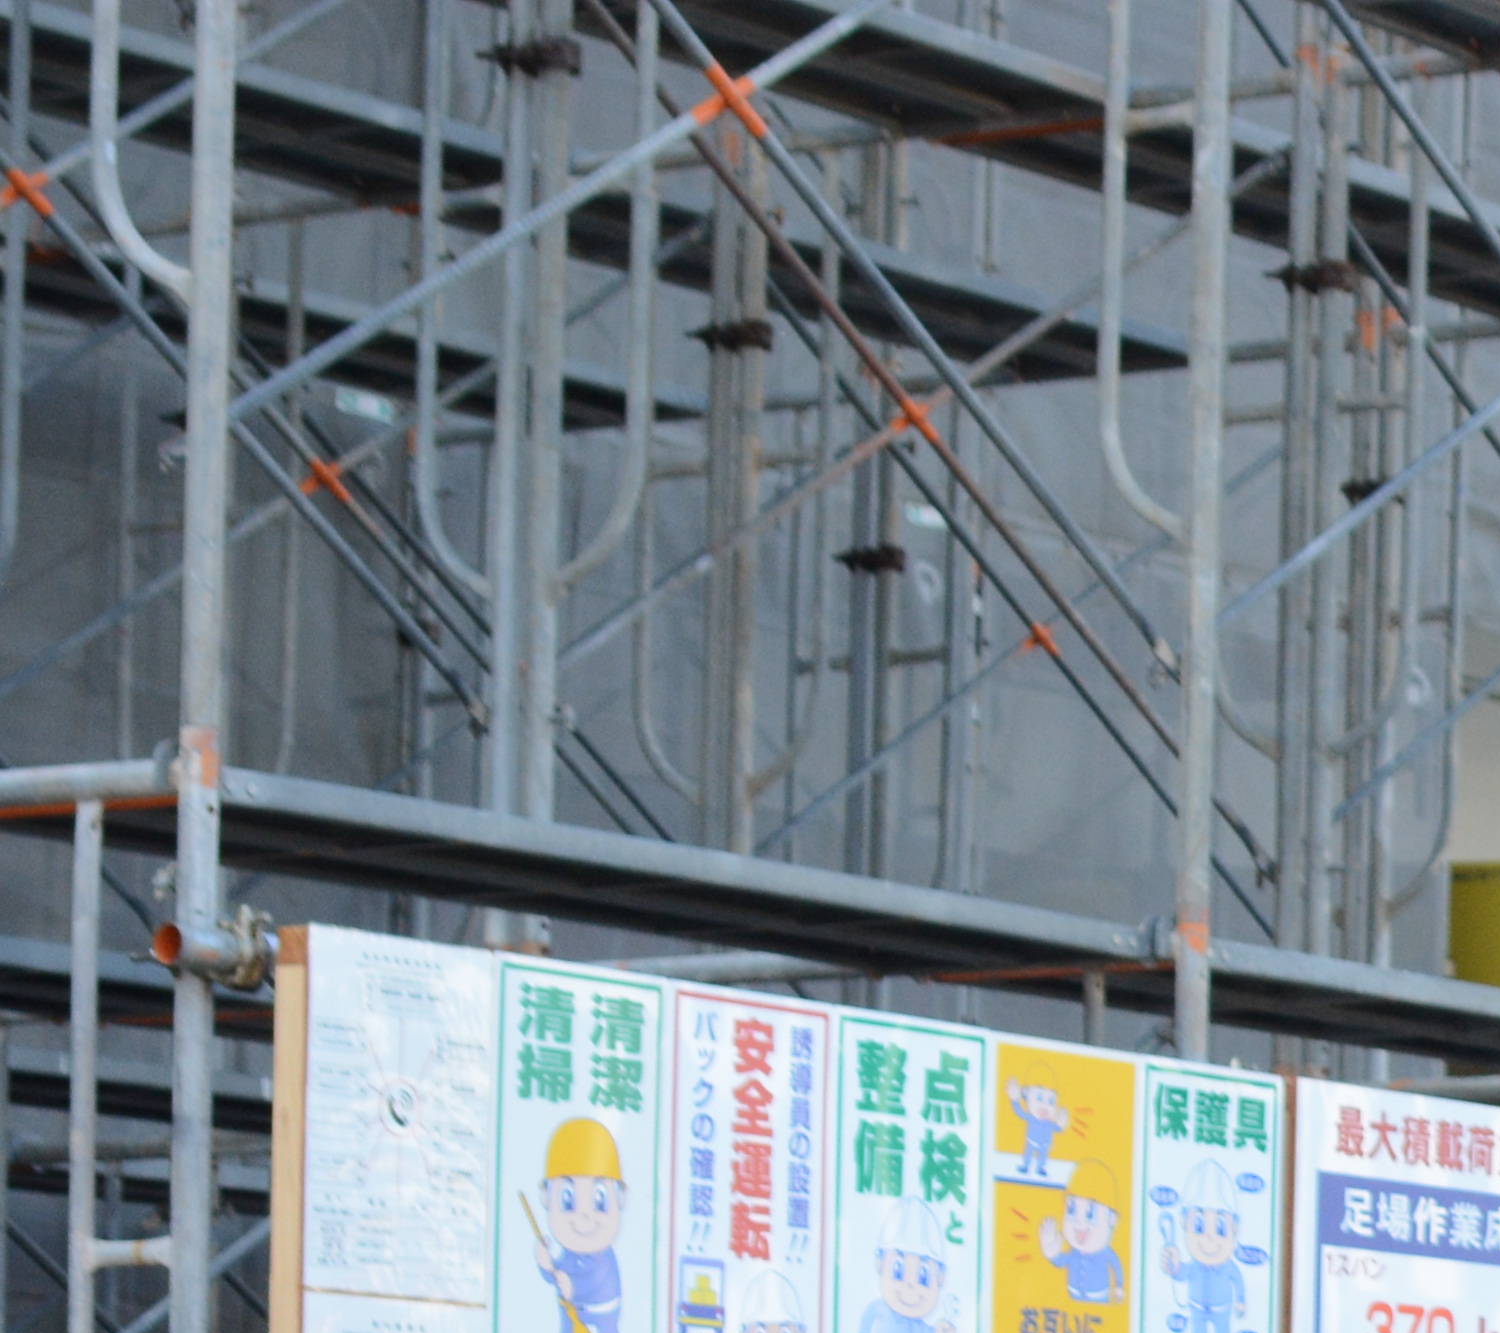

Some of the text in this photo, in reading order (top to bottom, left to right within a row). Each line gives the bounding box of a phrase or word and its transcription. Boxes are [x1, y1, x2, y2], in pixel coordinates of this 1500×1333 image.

[517, 982, 576, 1103] 清掃
[590, 993, 645, 1113] 清潔
[729, 1017, 775, 1261] 安全運転
[854, 1039, 908, 1198] 整備
[1154, 1082, 1268, 1153] 保護具
